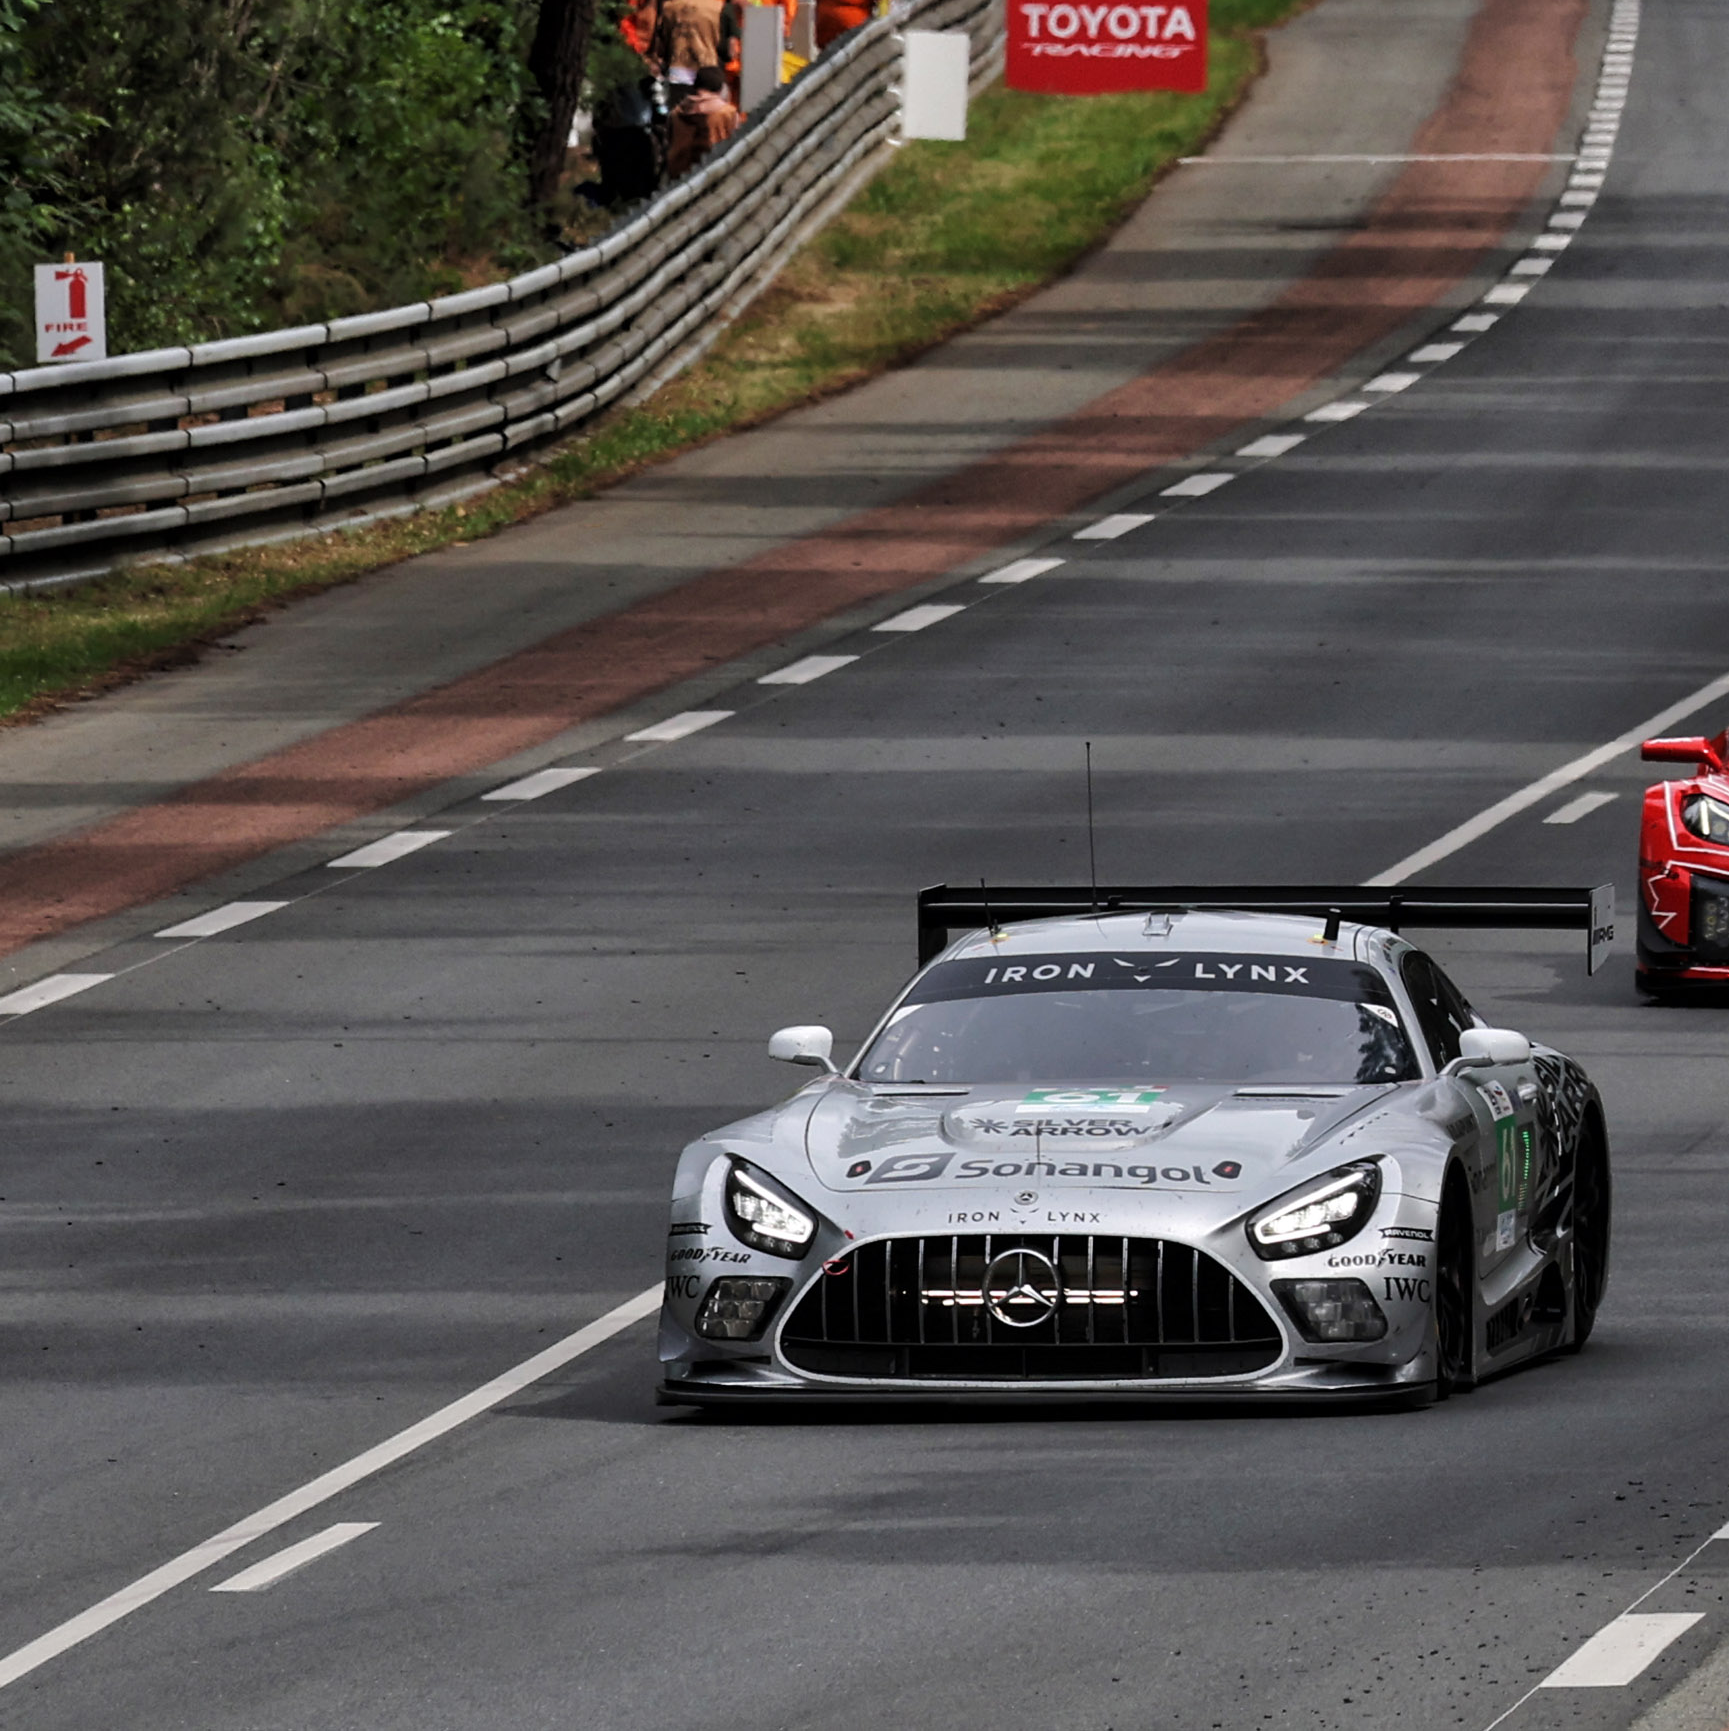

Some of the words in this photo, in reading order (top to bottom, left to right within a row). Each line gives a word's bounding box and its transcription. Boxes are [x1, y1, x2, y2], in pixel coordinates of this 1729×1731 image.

[1020, 3, 1196, 40] TOYOTA
[1021, 43, 1196, 58] RACING
[45, 322, 88, 333] FIRE
[984, 963, 1095, 984] IRON
[1194, 963, 1309, 984] LYNX
[1012, 1119, 1133, 1127] SILVER
[1008, 1127, 1152, 1137] ARROW
[955, 1159, 1211, 1184] Sonangol
[948, 1210, 1000, 1224] IRON
[1047, 1211, 1100, 1224] LYNX
[1384, 1276, 1431, 1303] IWC
